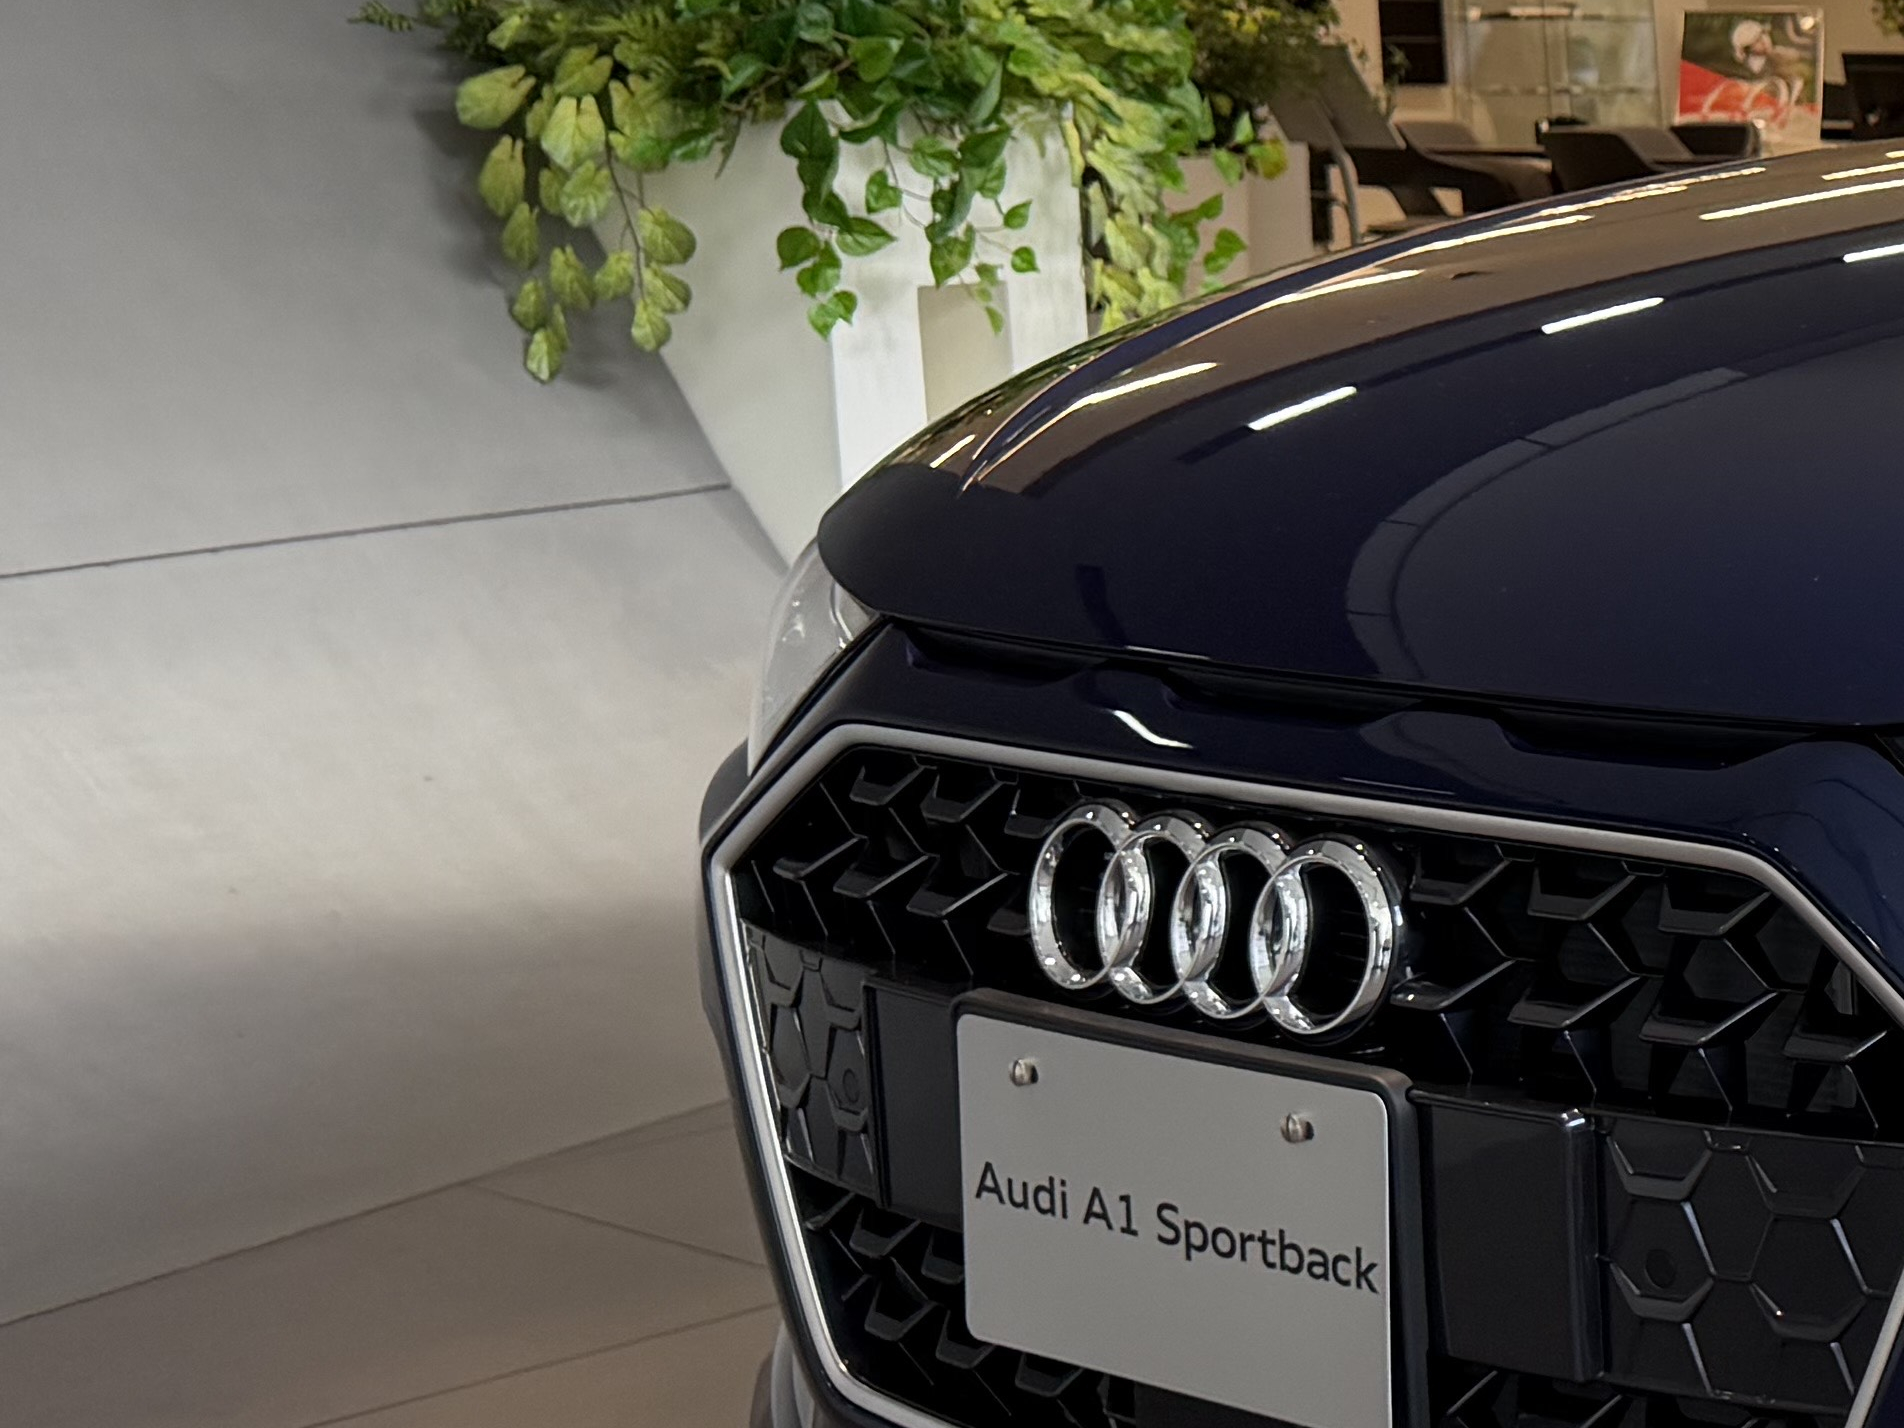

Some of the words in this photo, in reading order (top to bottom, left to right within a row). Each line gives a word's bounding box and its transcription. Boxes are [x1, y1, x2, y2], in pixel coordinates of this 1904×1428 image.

[975, 1161, 1068, 1220] Audi
[1083, 1186, 1139, 1236] A1
[1156, 1202, 1380, 1294] Sportback
